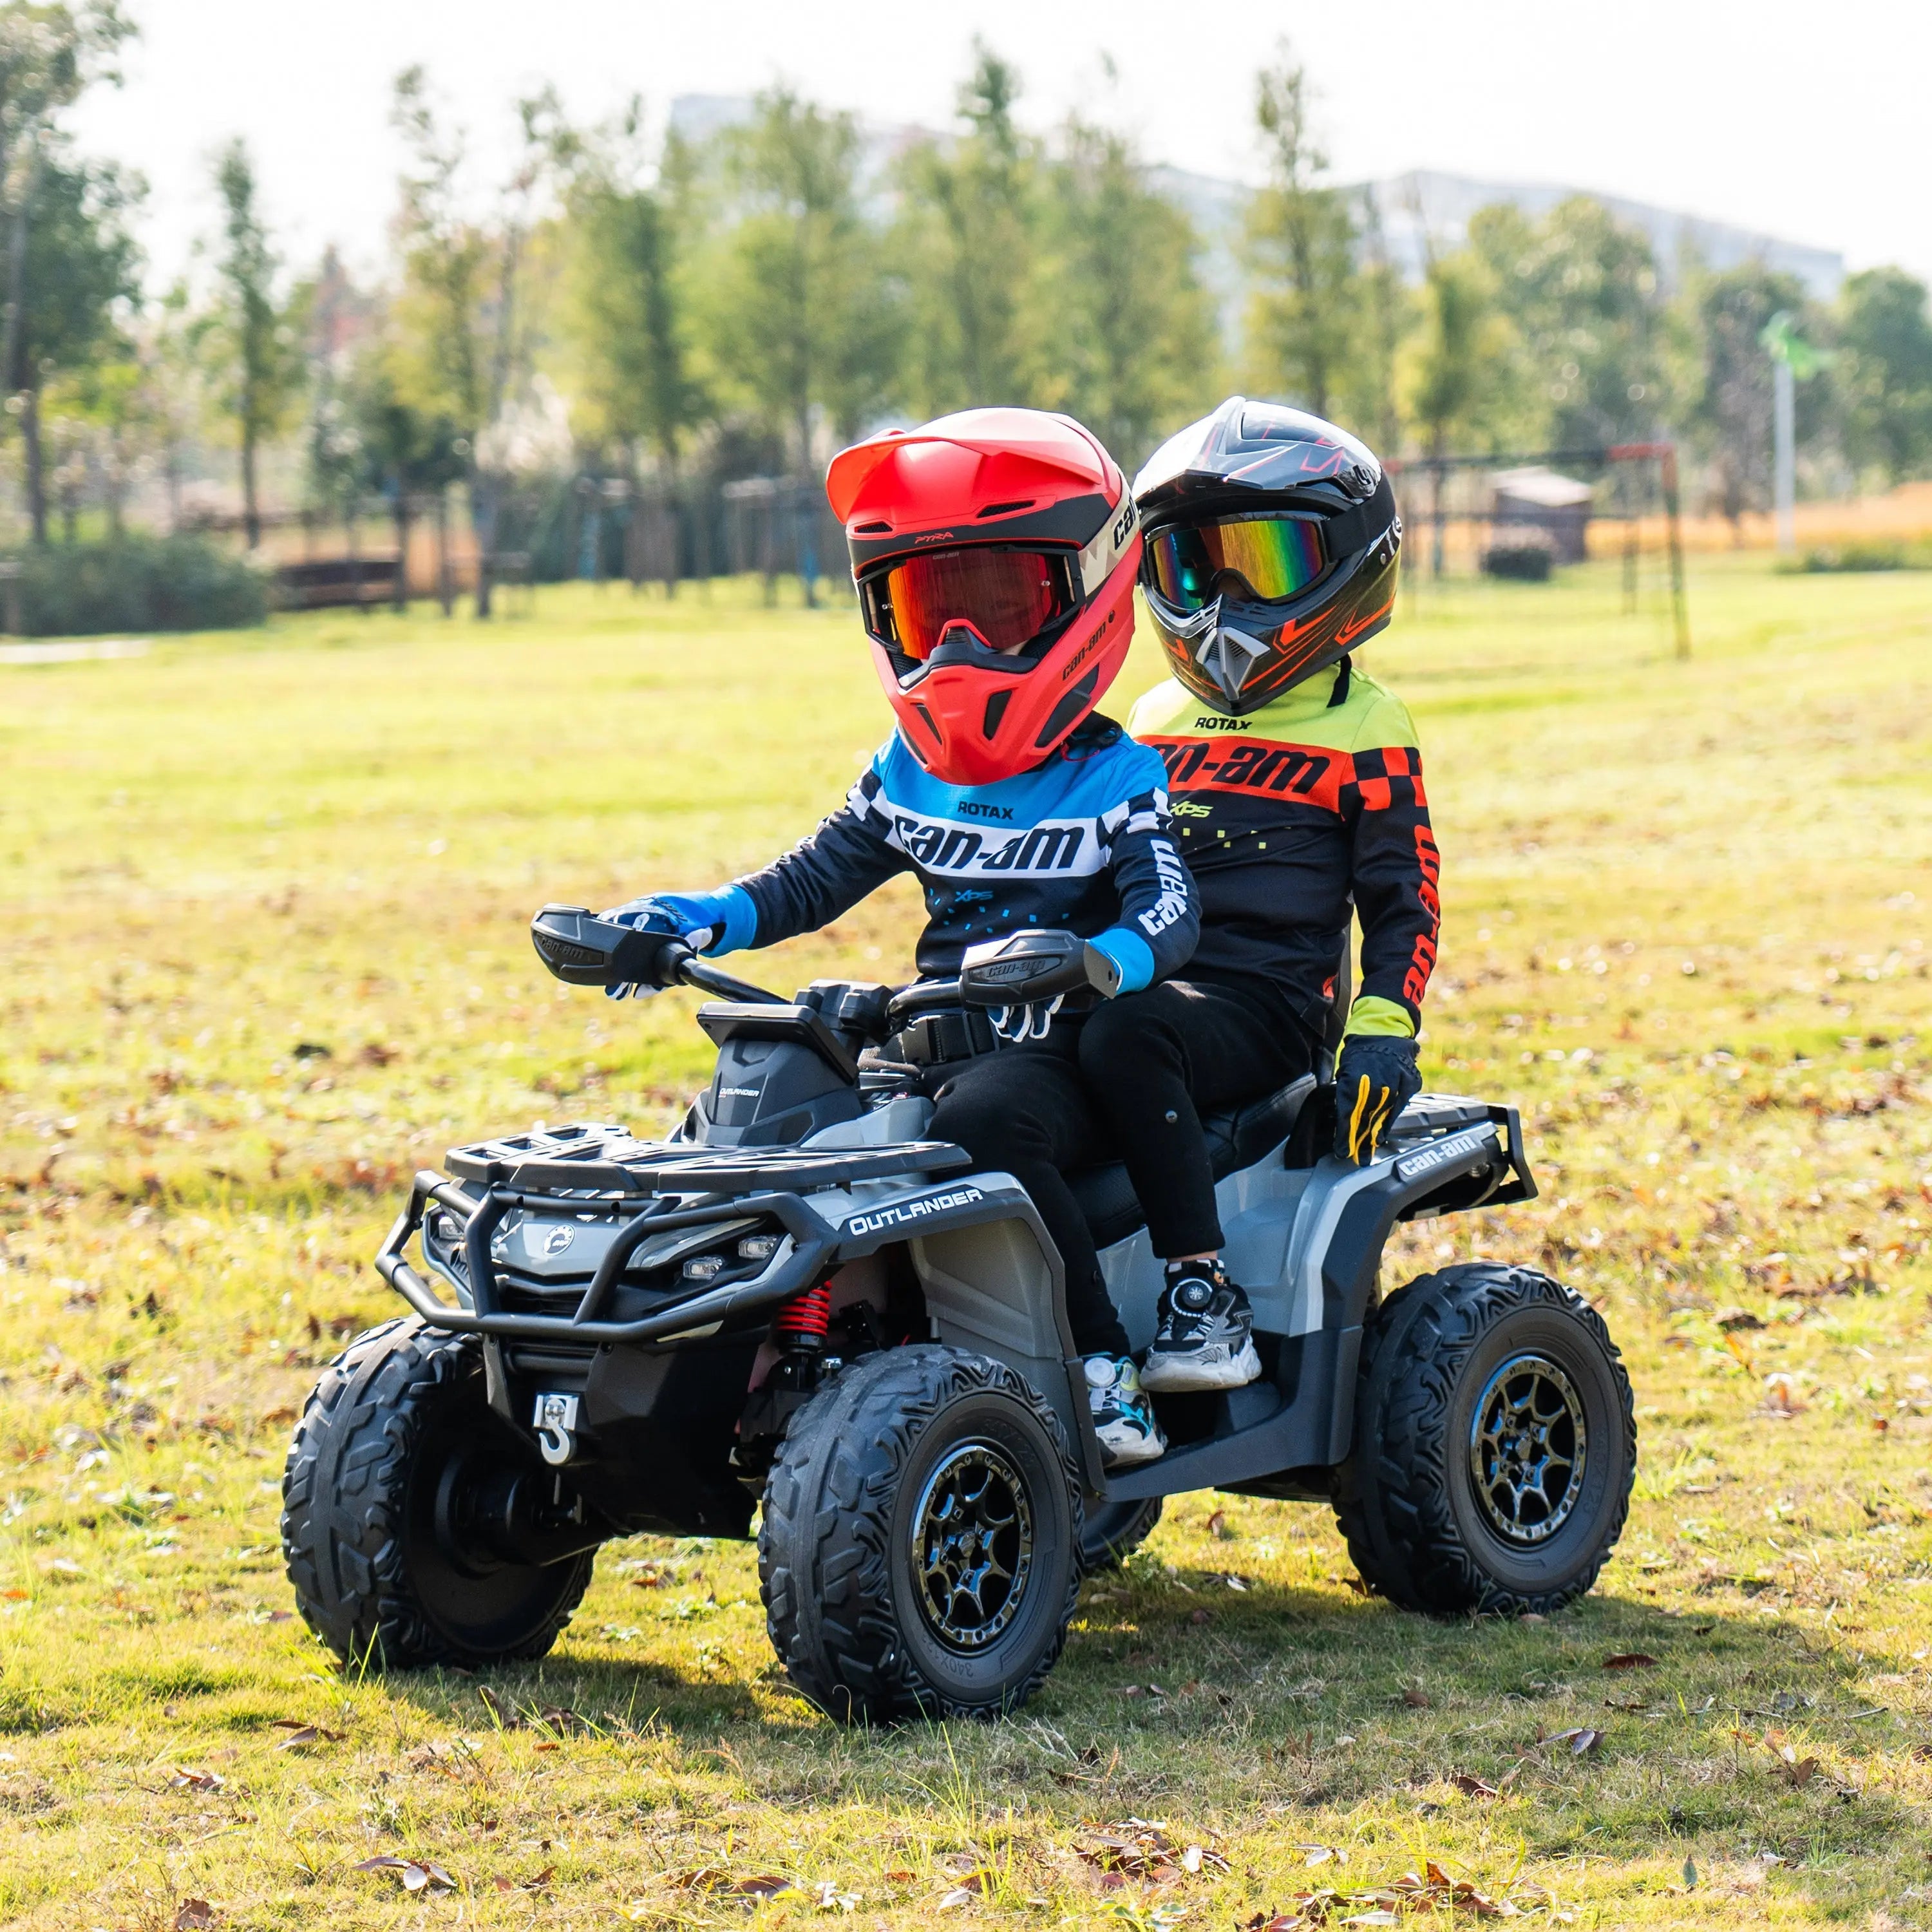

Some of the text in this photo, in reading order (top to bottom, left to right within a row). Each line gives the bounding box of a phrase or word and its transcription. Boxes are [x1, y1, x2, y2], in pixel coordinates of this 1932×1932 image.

[1062, 621, 1106, 681] can-am
[1195, 717, 1253, 730] ROTAX
[1151, 742, 1331, 794] n-am
[957, 800, 1014, 820] ROTAX
[895, 814, 1085, 870] can-am
[986, 959, 1046, 978] can-am
[1399, 1135, 1477, 1176] can-am
[849, 1188, 984, 1236] OUTLANDER
